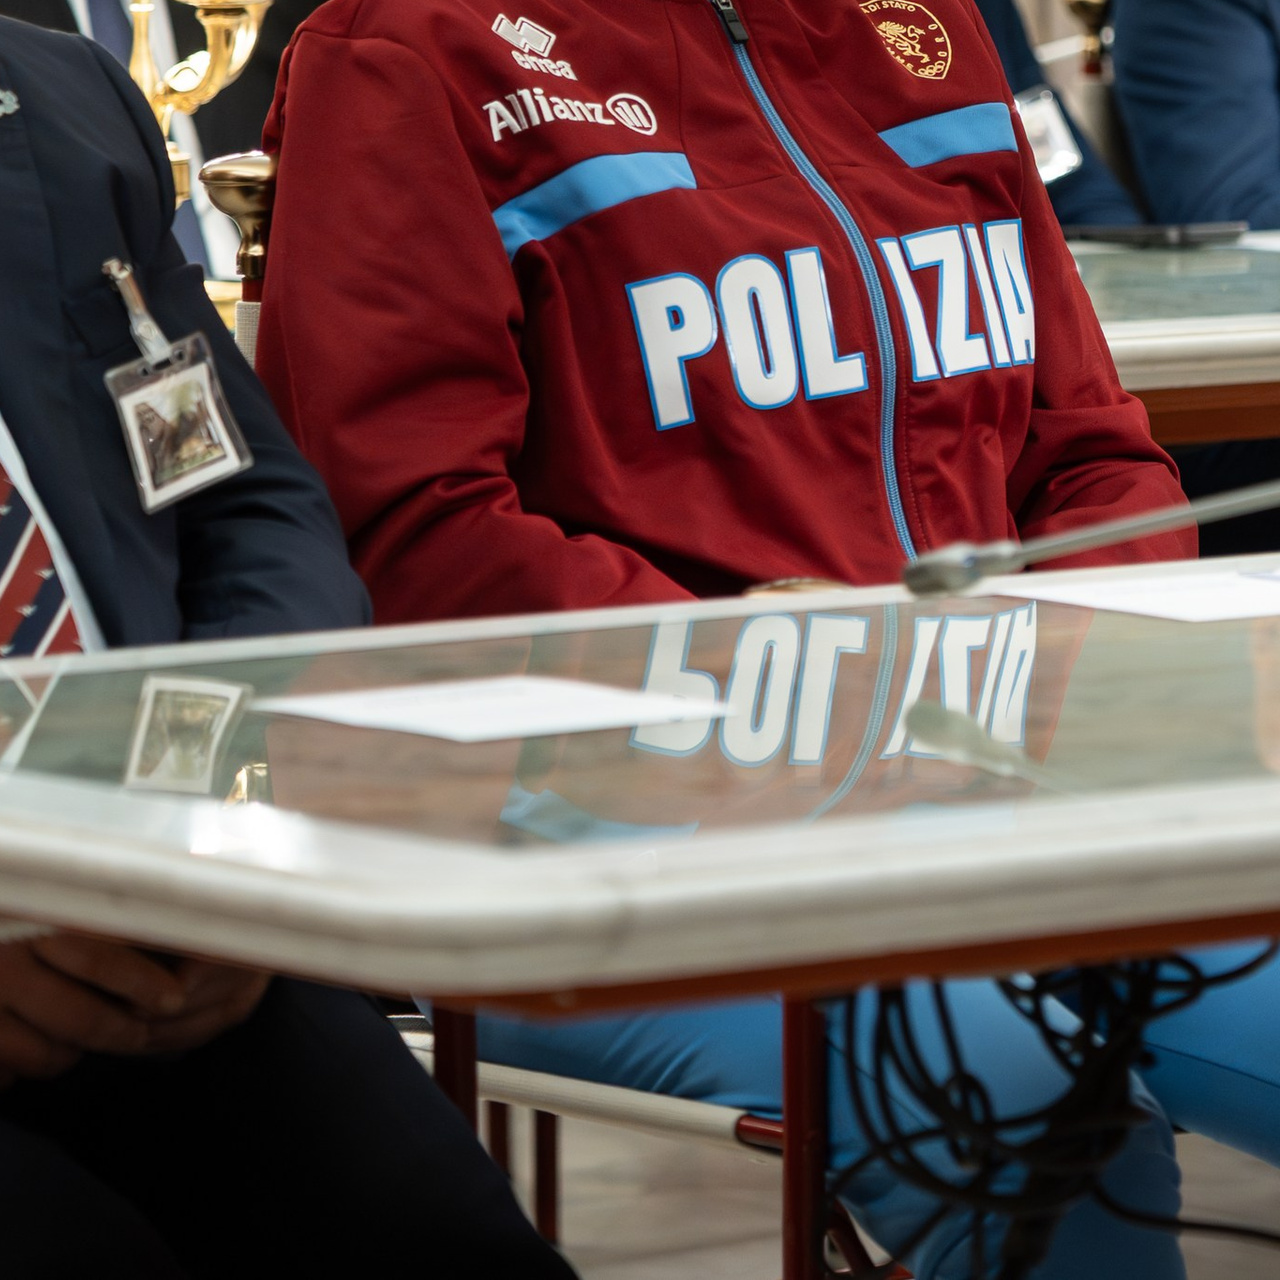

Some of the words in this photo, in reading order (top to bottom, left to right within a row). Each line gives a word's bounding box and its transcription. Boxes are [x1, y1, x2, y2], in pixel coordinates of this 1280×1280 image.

[881, 0, 916, 12] STATO
[482, 87, 616, 142] Allianz
[624, 217, 1036, 431] POLIZIA
